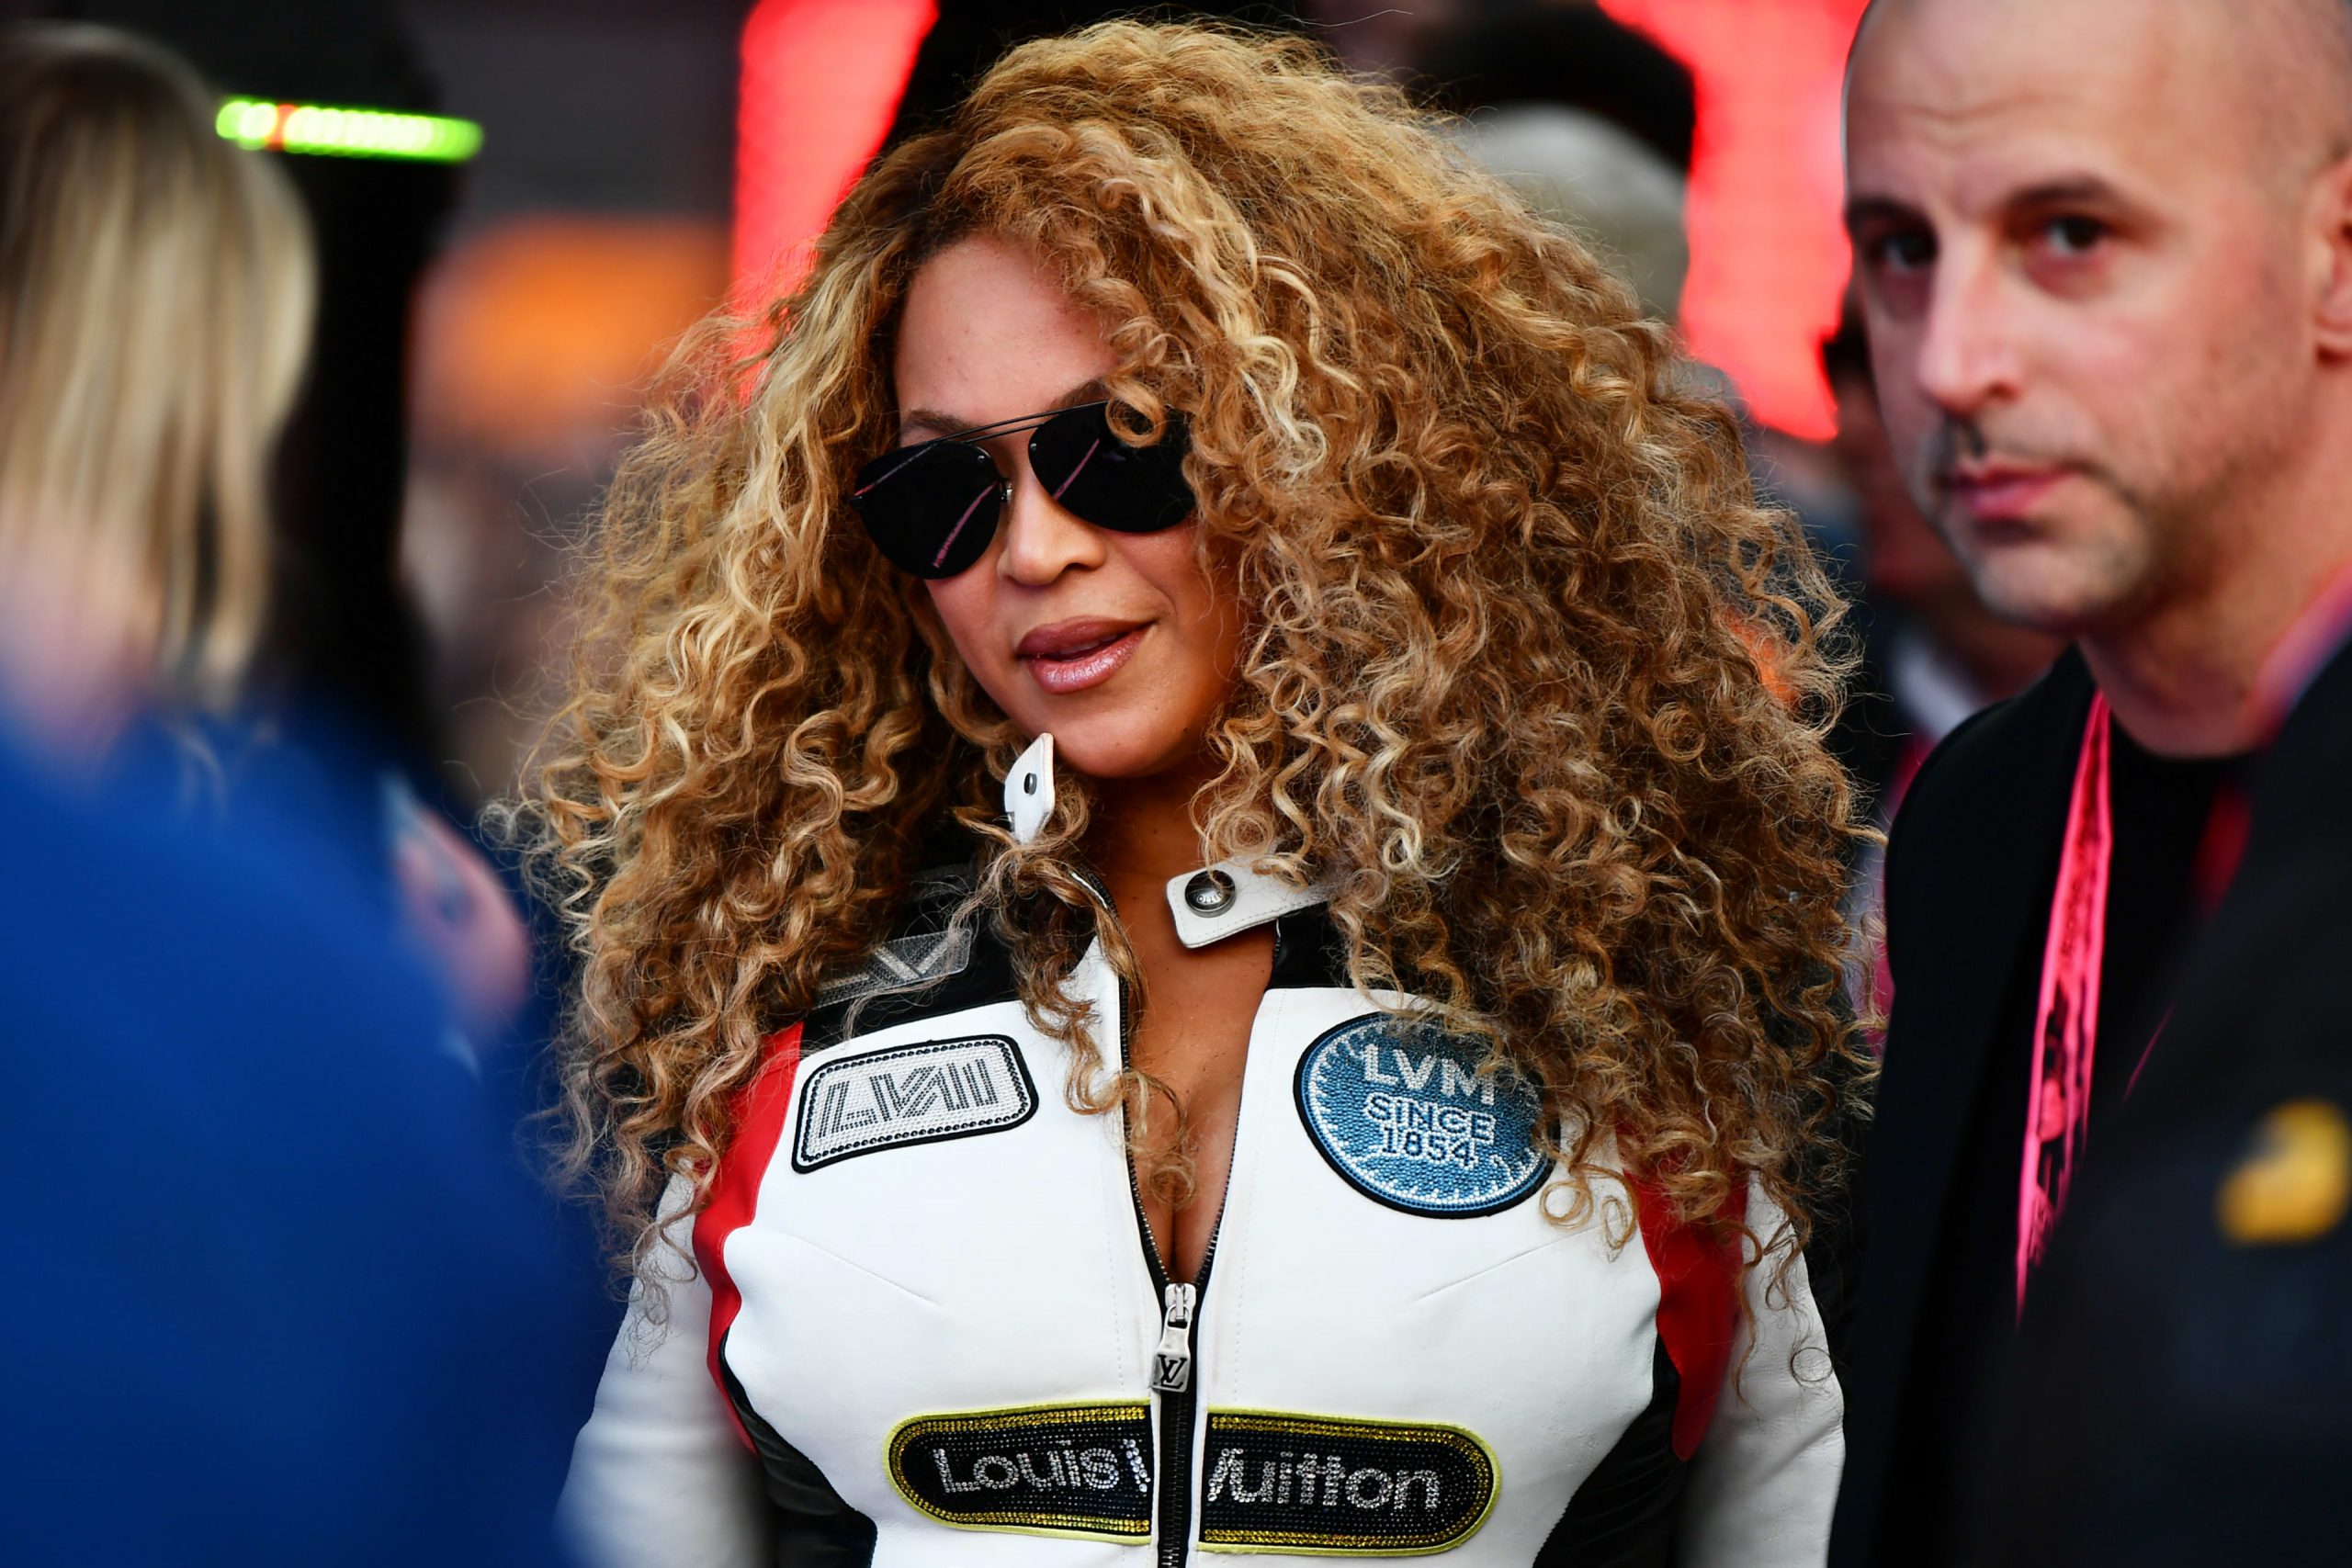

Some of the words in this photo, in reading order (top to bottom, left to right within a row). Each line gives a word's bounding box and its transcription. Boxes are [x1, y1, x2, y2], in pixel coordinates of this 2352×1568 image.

[1363, 1043, 1495, 1106] LVM
[1363, 1091, 1496, 1145] SINCE
[1380, 1123, 1478, 1170] 1854
[933, 1438, 1119, 1494] Louis
